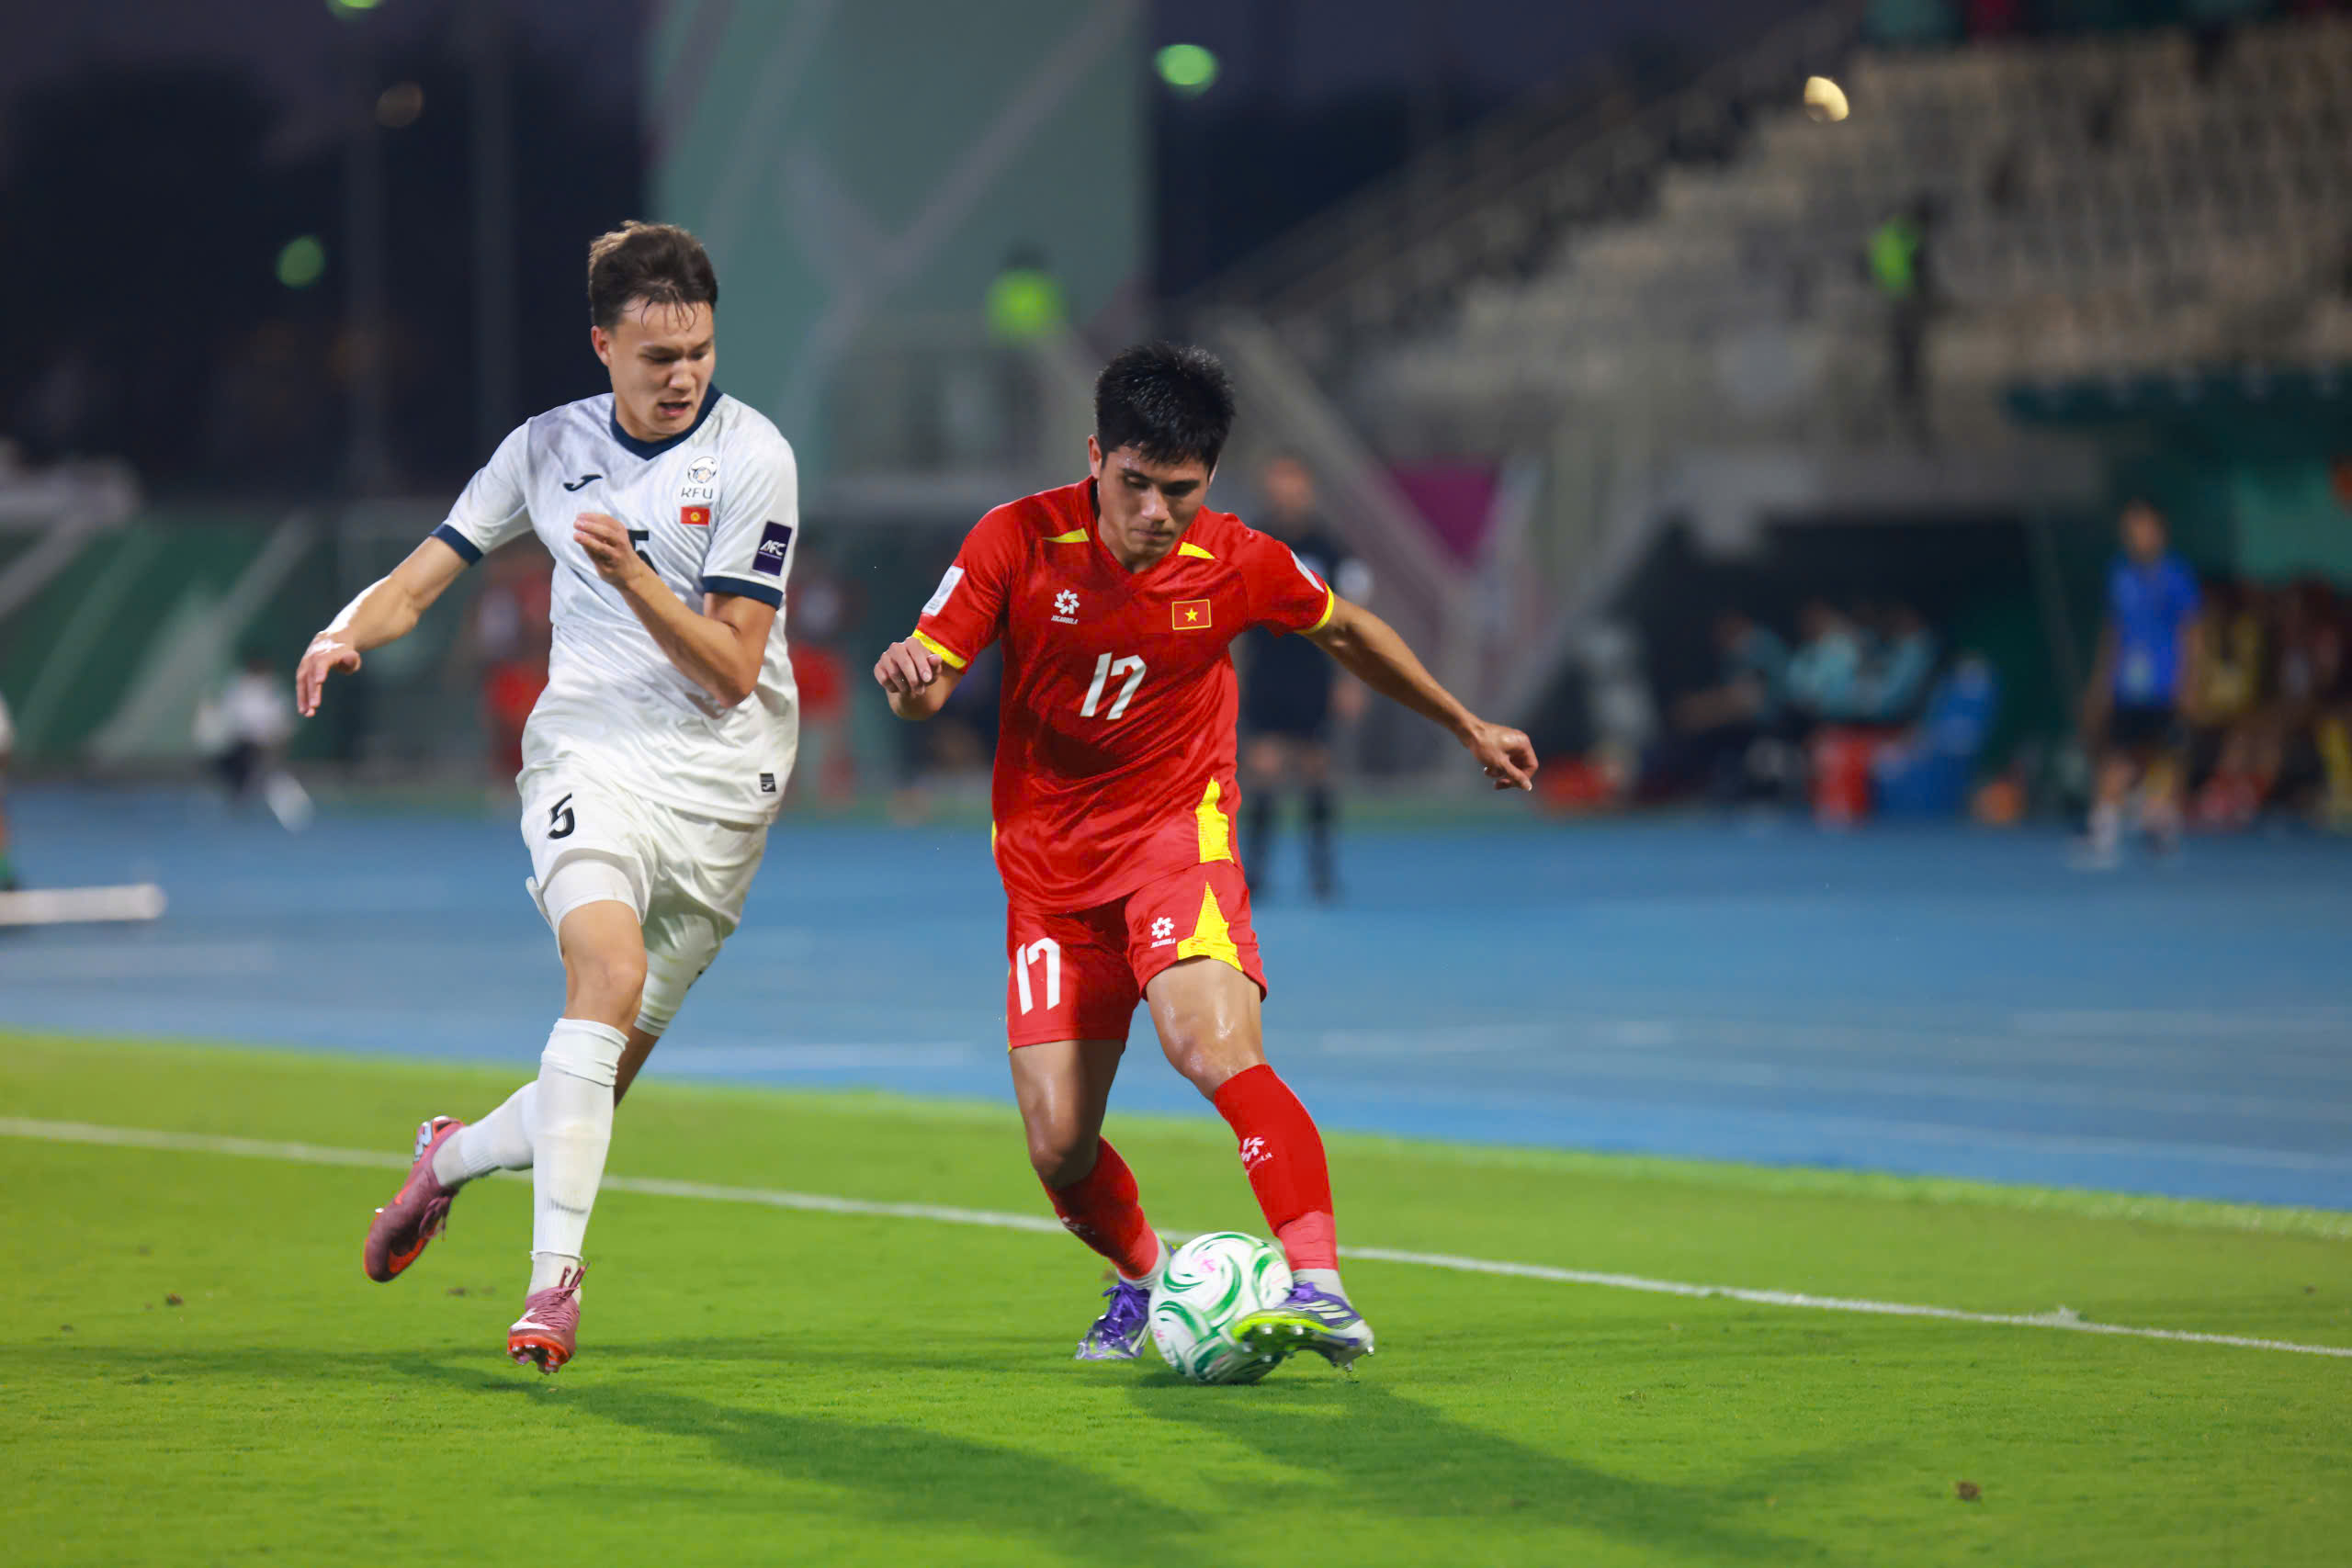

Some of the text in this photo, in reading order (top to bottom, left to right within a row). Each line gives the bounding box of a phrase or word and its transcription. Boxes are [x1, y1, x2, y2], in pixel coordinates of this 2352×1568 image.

[681, 487, 714, 500] KFU
[759, 539, 787, 557] AFC
[1080, 651, 1148, 721] 17
[548, 793, 575, 840] 5
[1016, 937, 1061, 1016] 17
